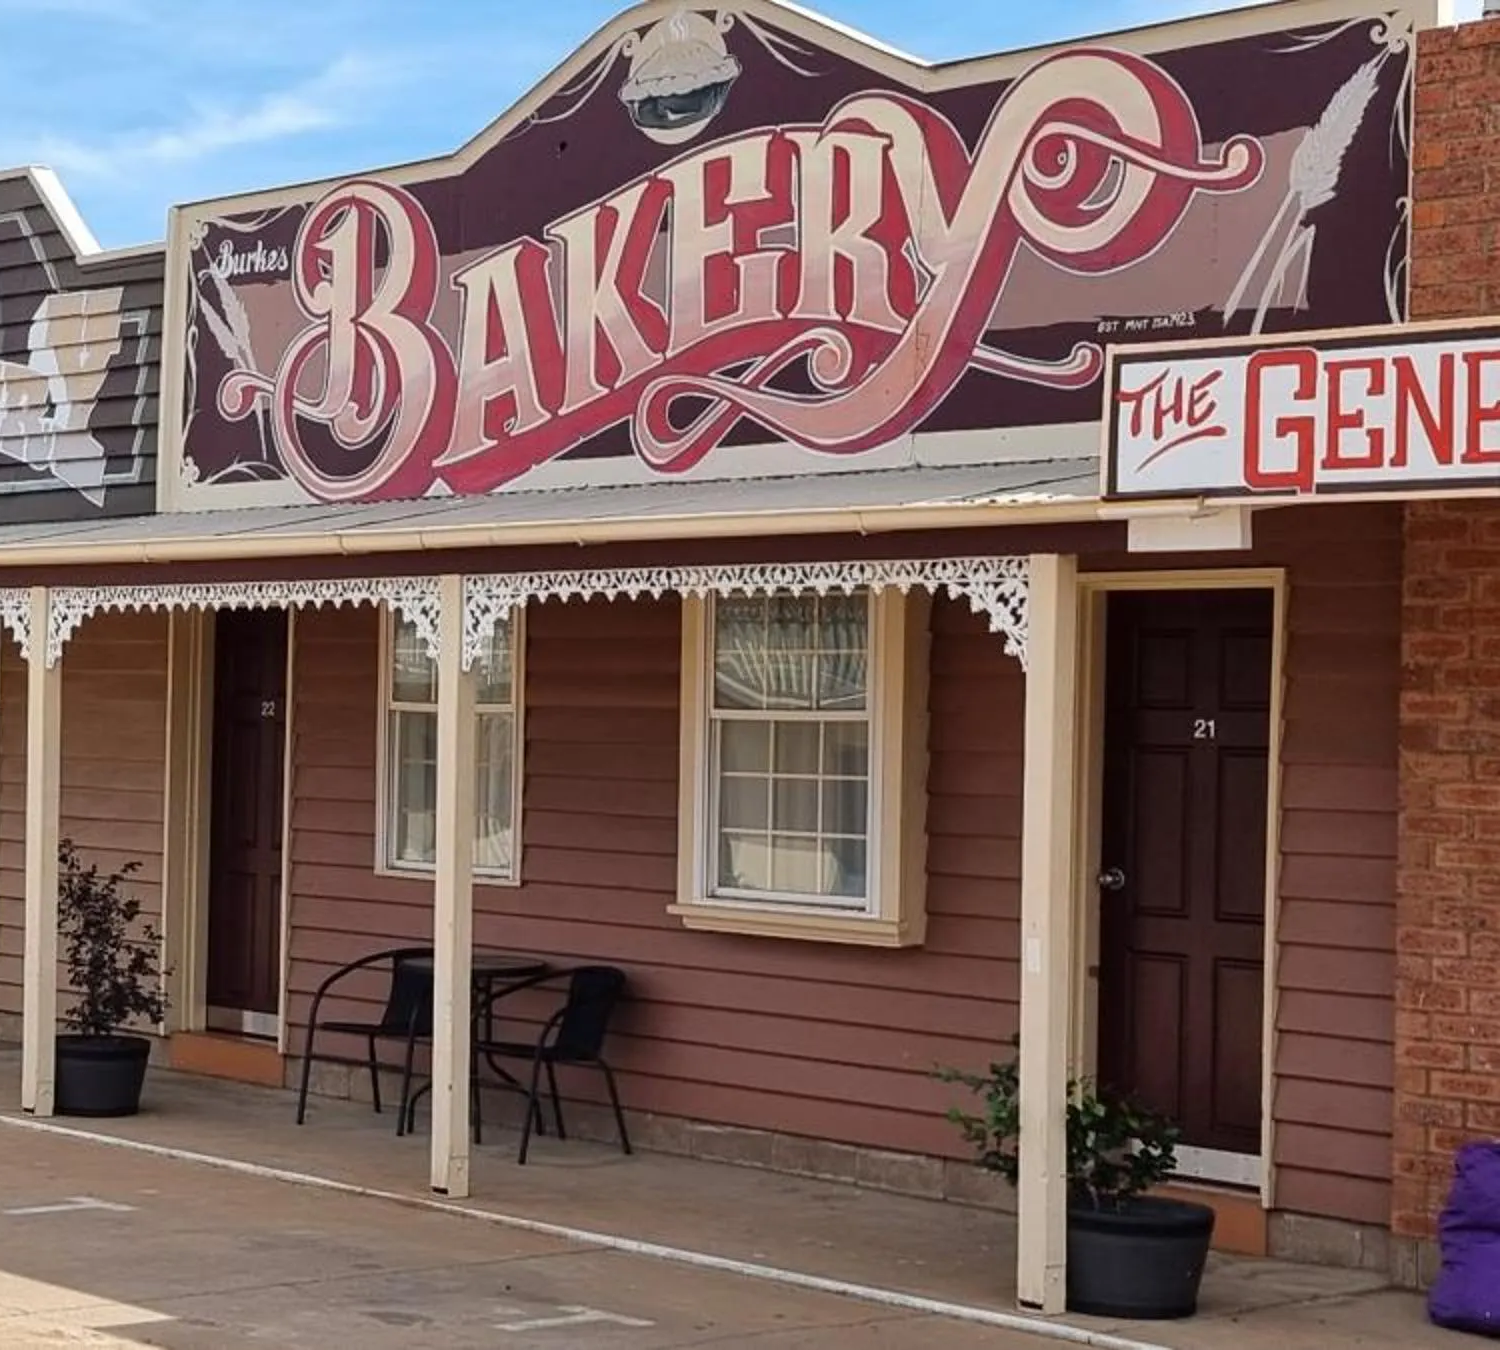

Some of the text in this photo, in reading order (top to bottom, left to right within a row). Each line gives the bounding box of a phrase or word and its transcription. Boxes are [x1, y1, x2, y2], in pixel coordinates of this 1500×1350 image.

[220, 47, 1265, 503] BAKERY
[1115, 367, 1223, 441] THE
[261, 700, 276, 717] 22
[1193, 718, 1216, 739] 21
